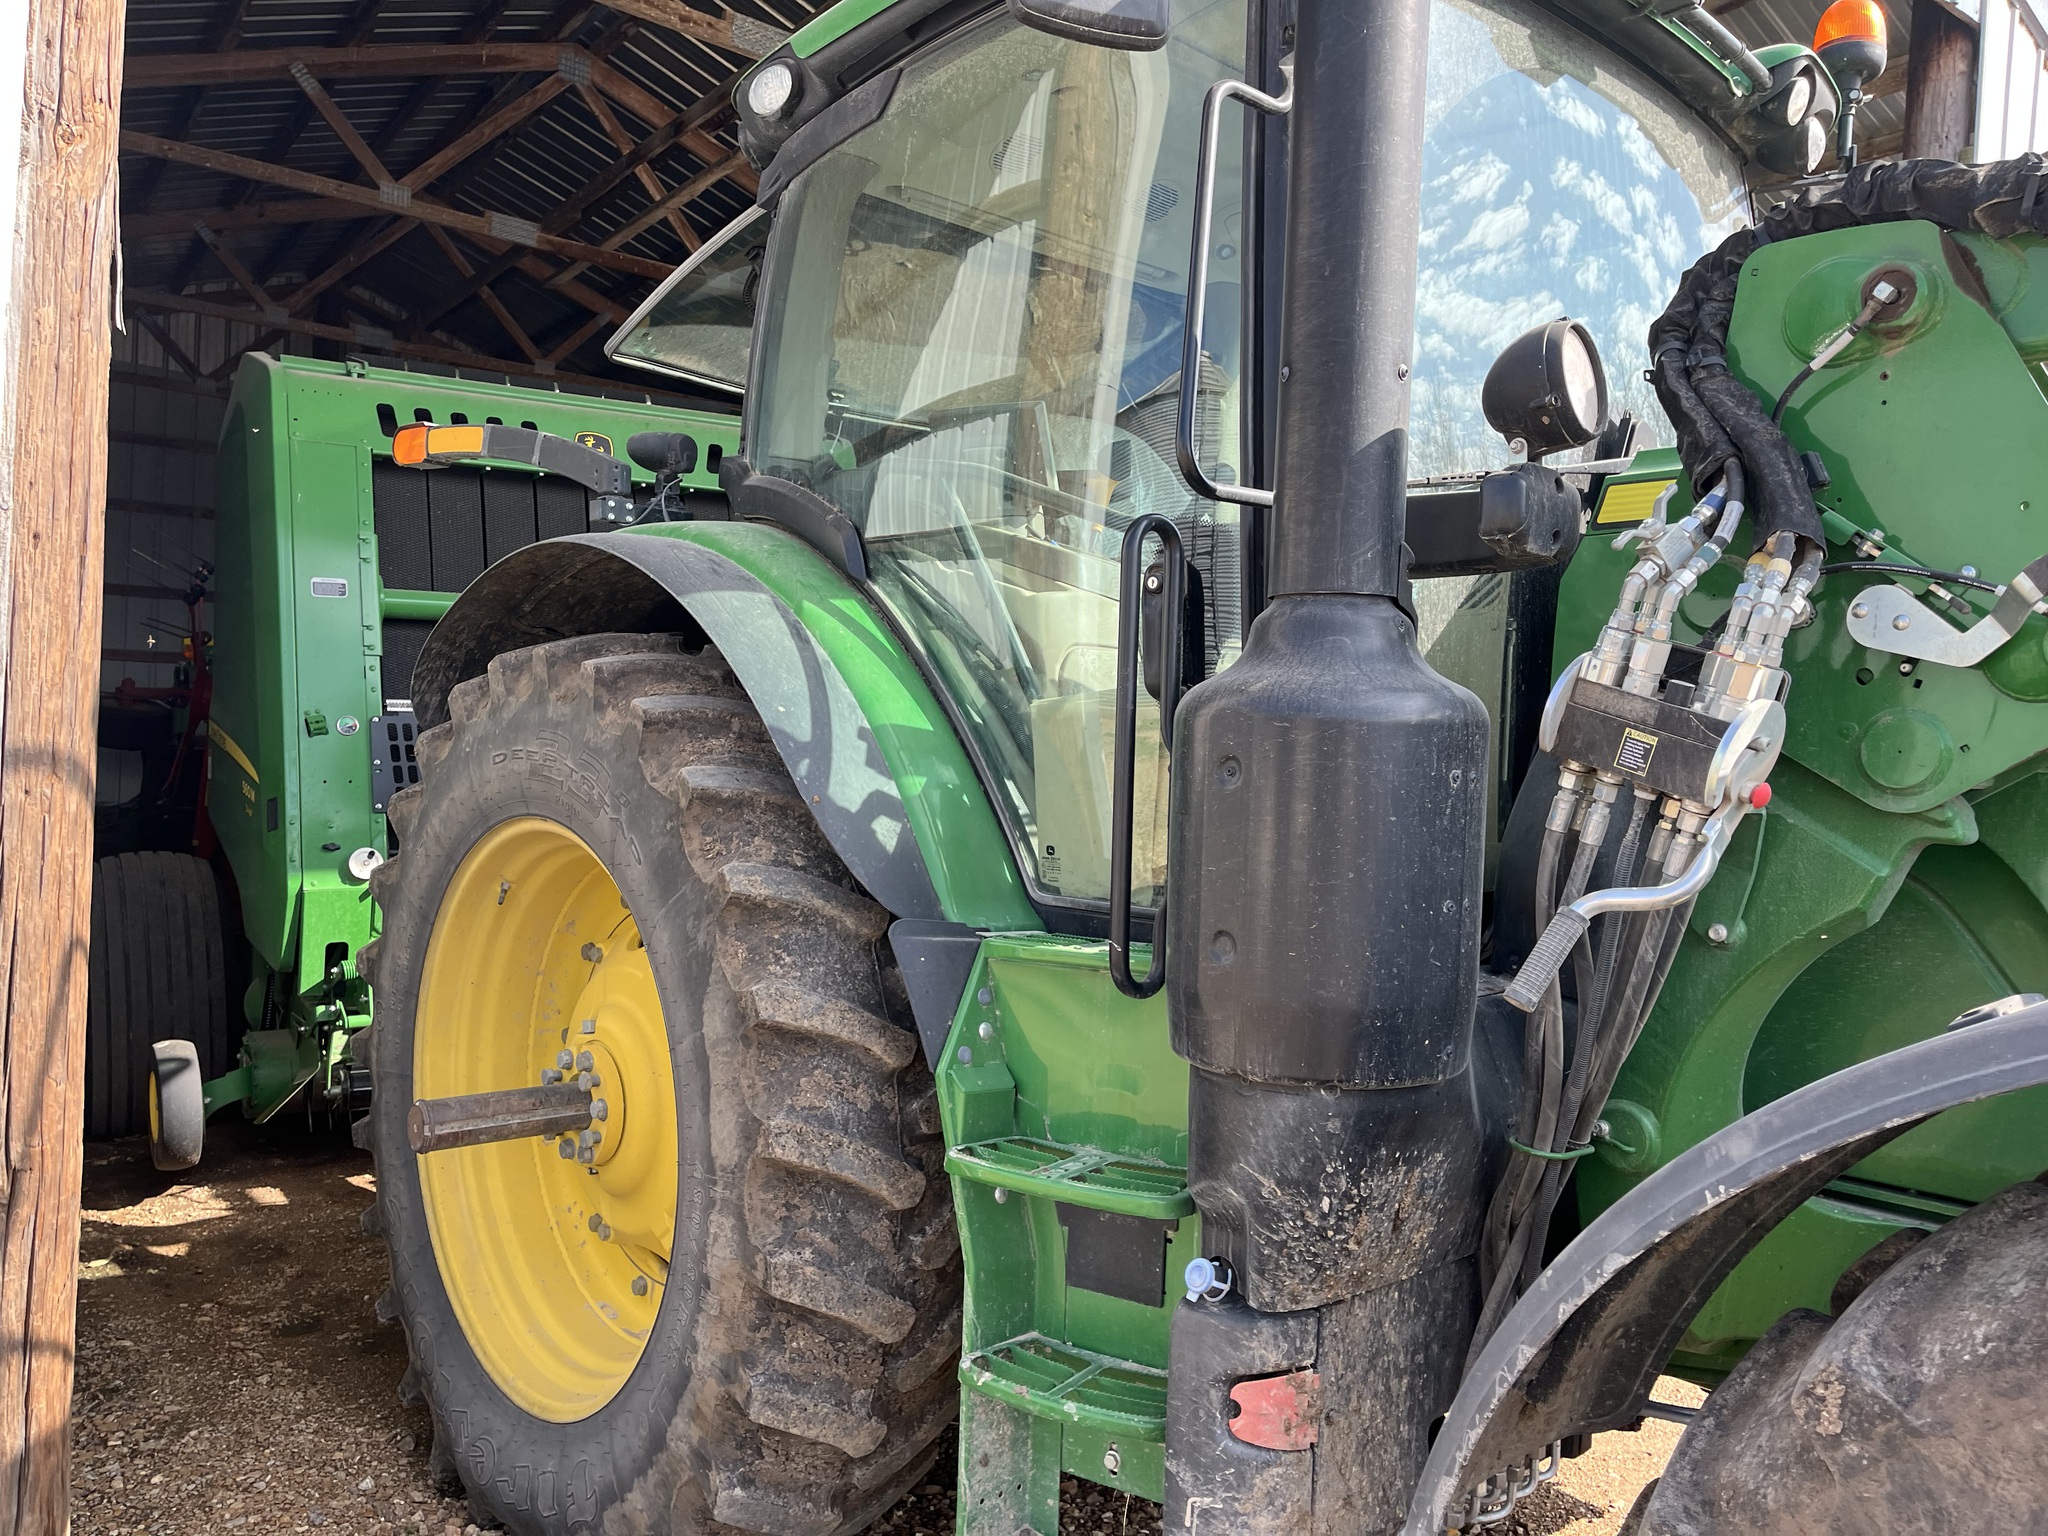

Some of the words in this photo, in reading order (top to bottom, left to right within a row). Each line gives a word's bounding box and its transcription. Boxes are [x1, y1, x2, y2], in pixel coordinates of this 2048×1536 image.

[1632, 731, 1656, 743] CAUTION
[492, 749, 557, 765] DEEP
[563, 762, 642, 866] TREAD
[386, 1198, 598, 1528] Firestone
